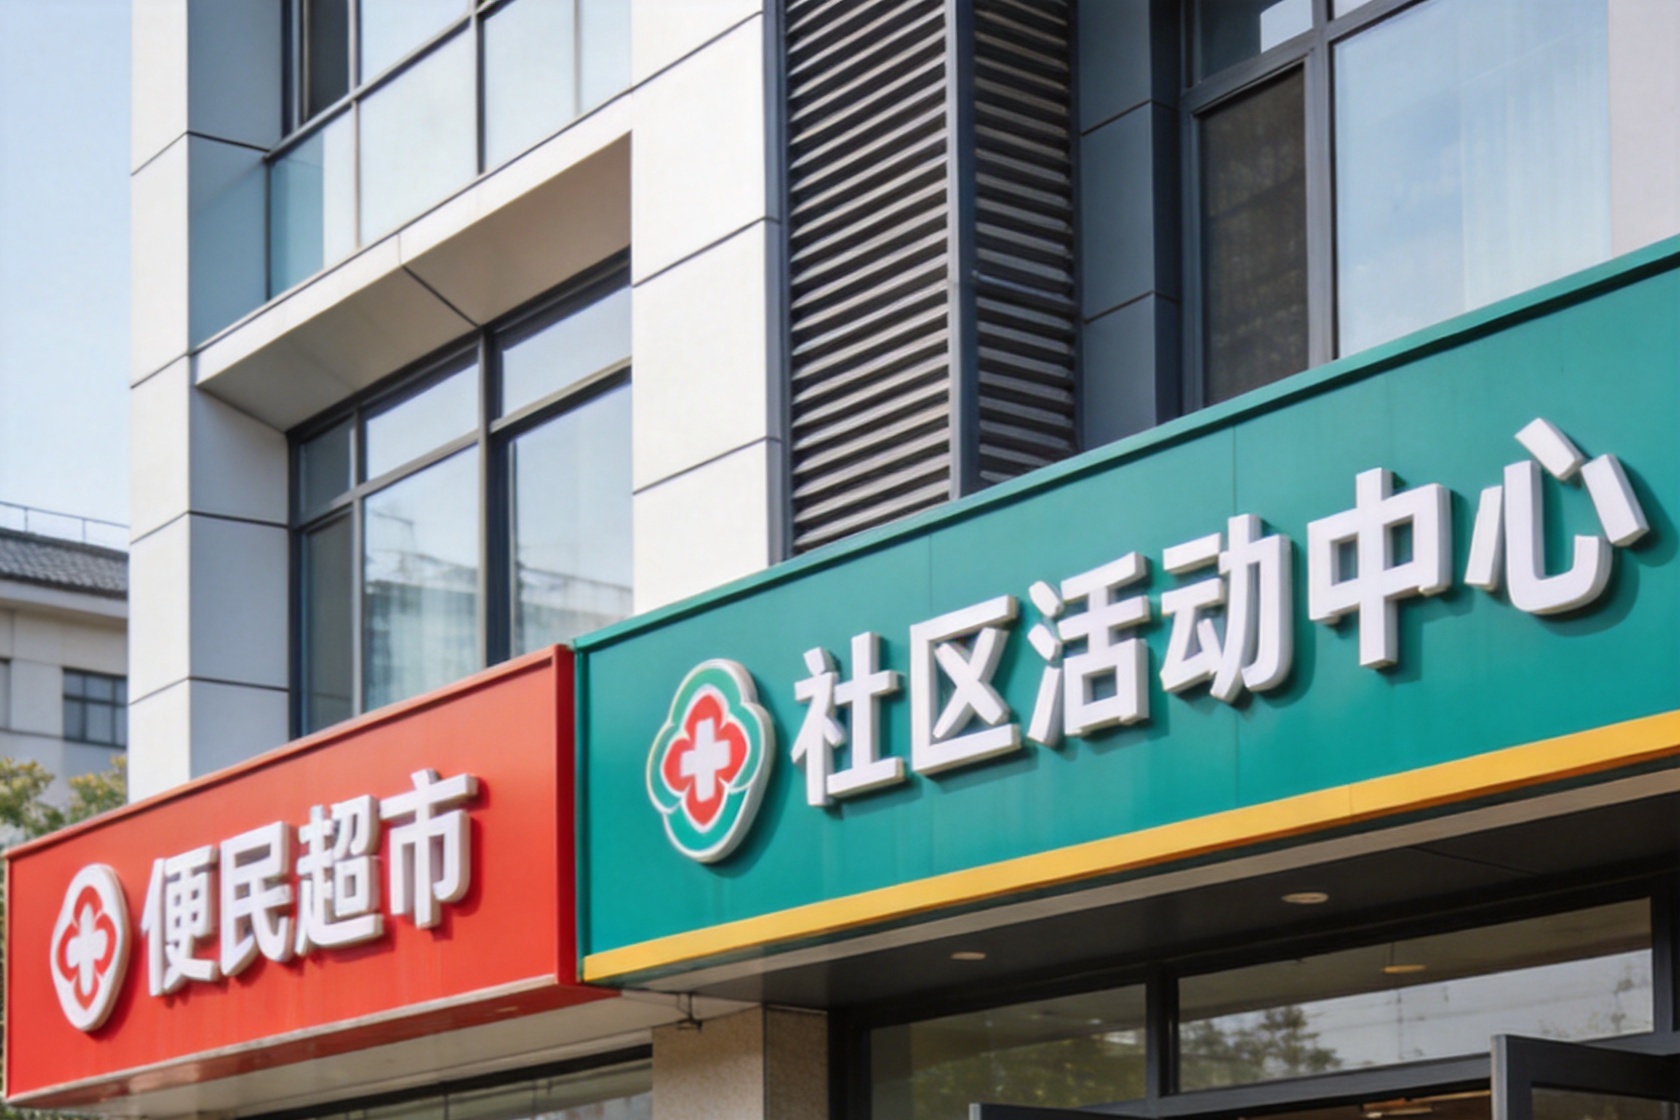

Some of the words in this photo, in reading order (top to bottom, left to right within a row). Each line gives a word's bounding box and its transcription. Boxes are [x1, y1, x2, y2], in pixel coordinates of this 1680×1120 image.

[791, 417, 1649, 806] 社区活动中心
[141, 768, 478, 997] 便民超市
